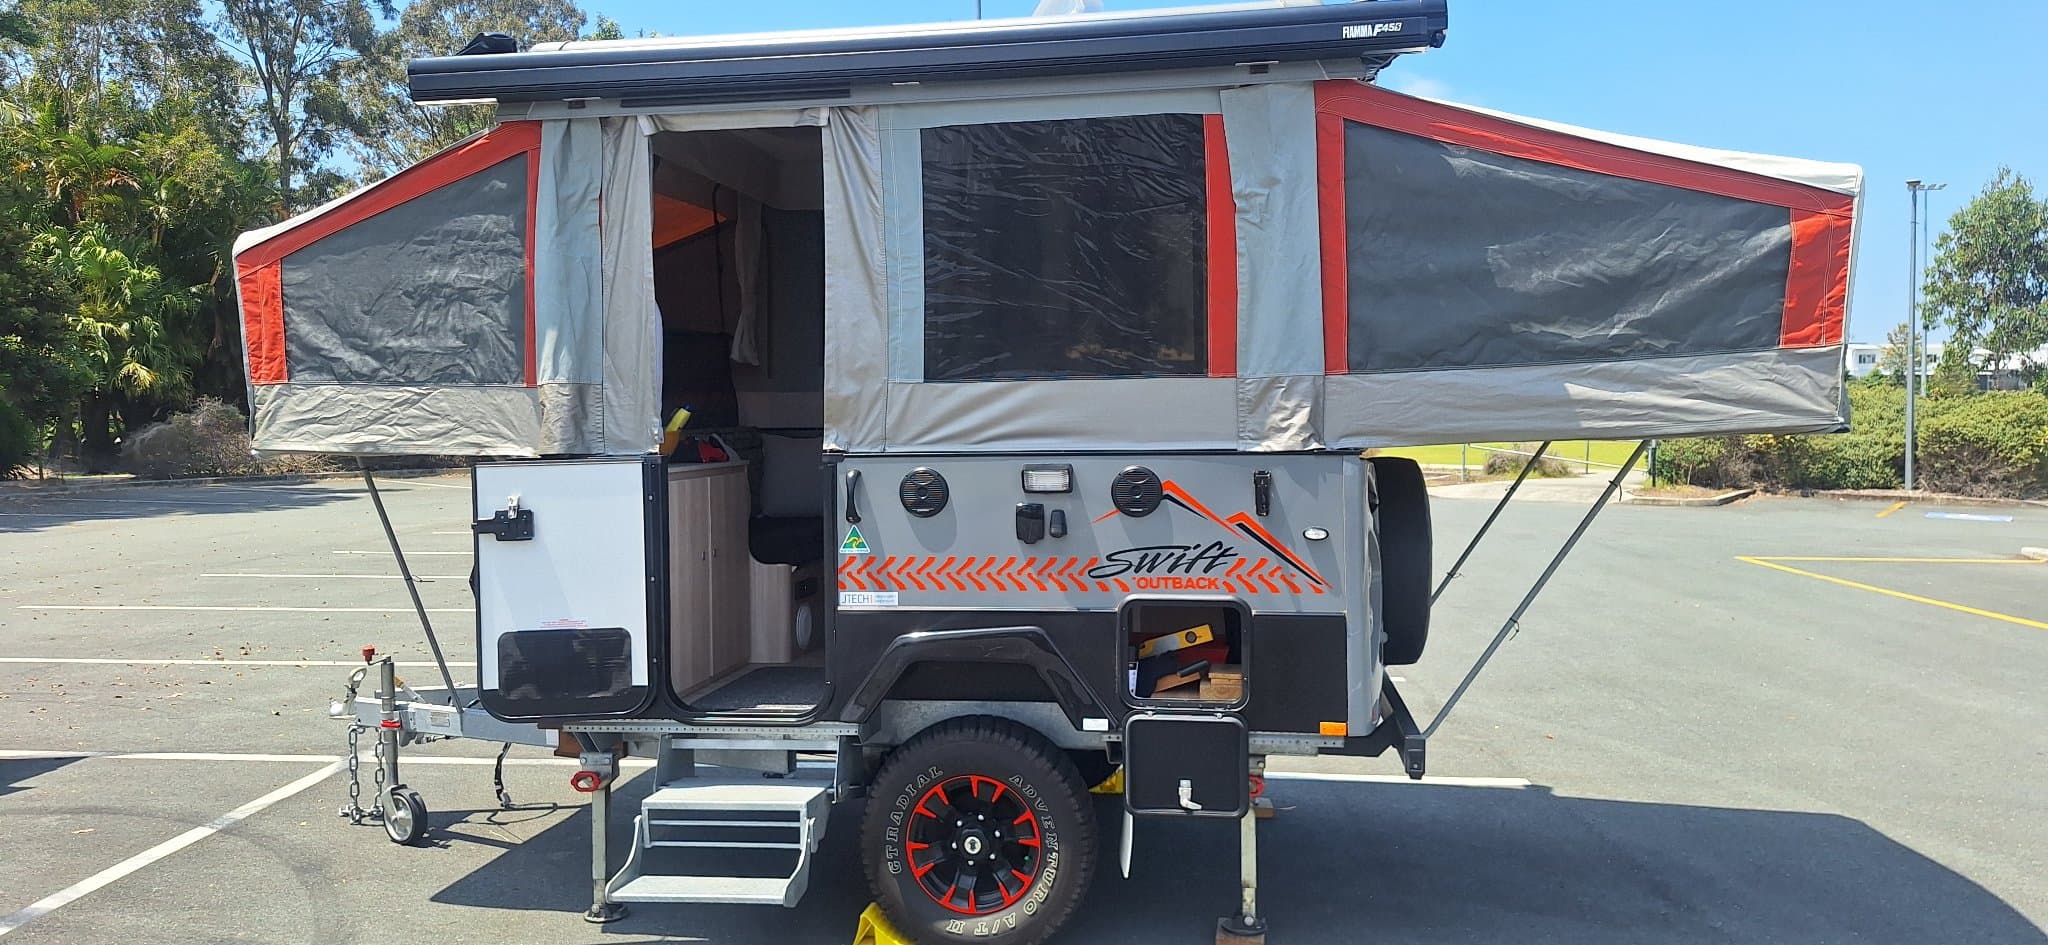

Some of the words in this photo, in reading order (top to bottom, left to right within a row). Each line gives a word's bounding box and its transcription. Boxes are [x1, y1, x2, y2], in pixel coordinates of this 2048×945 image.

[1342, 24, 1373, 39] FIAMMA
[1087, 540, 1239, 579] Swift
[1135, 576, 1220, 590] OUTBACK
[1008, 774, 1059, 915] ADVENTURO
